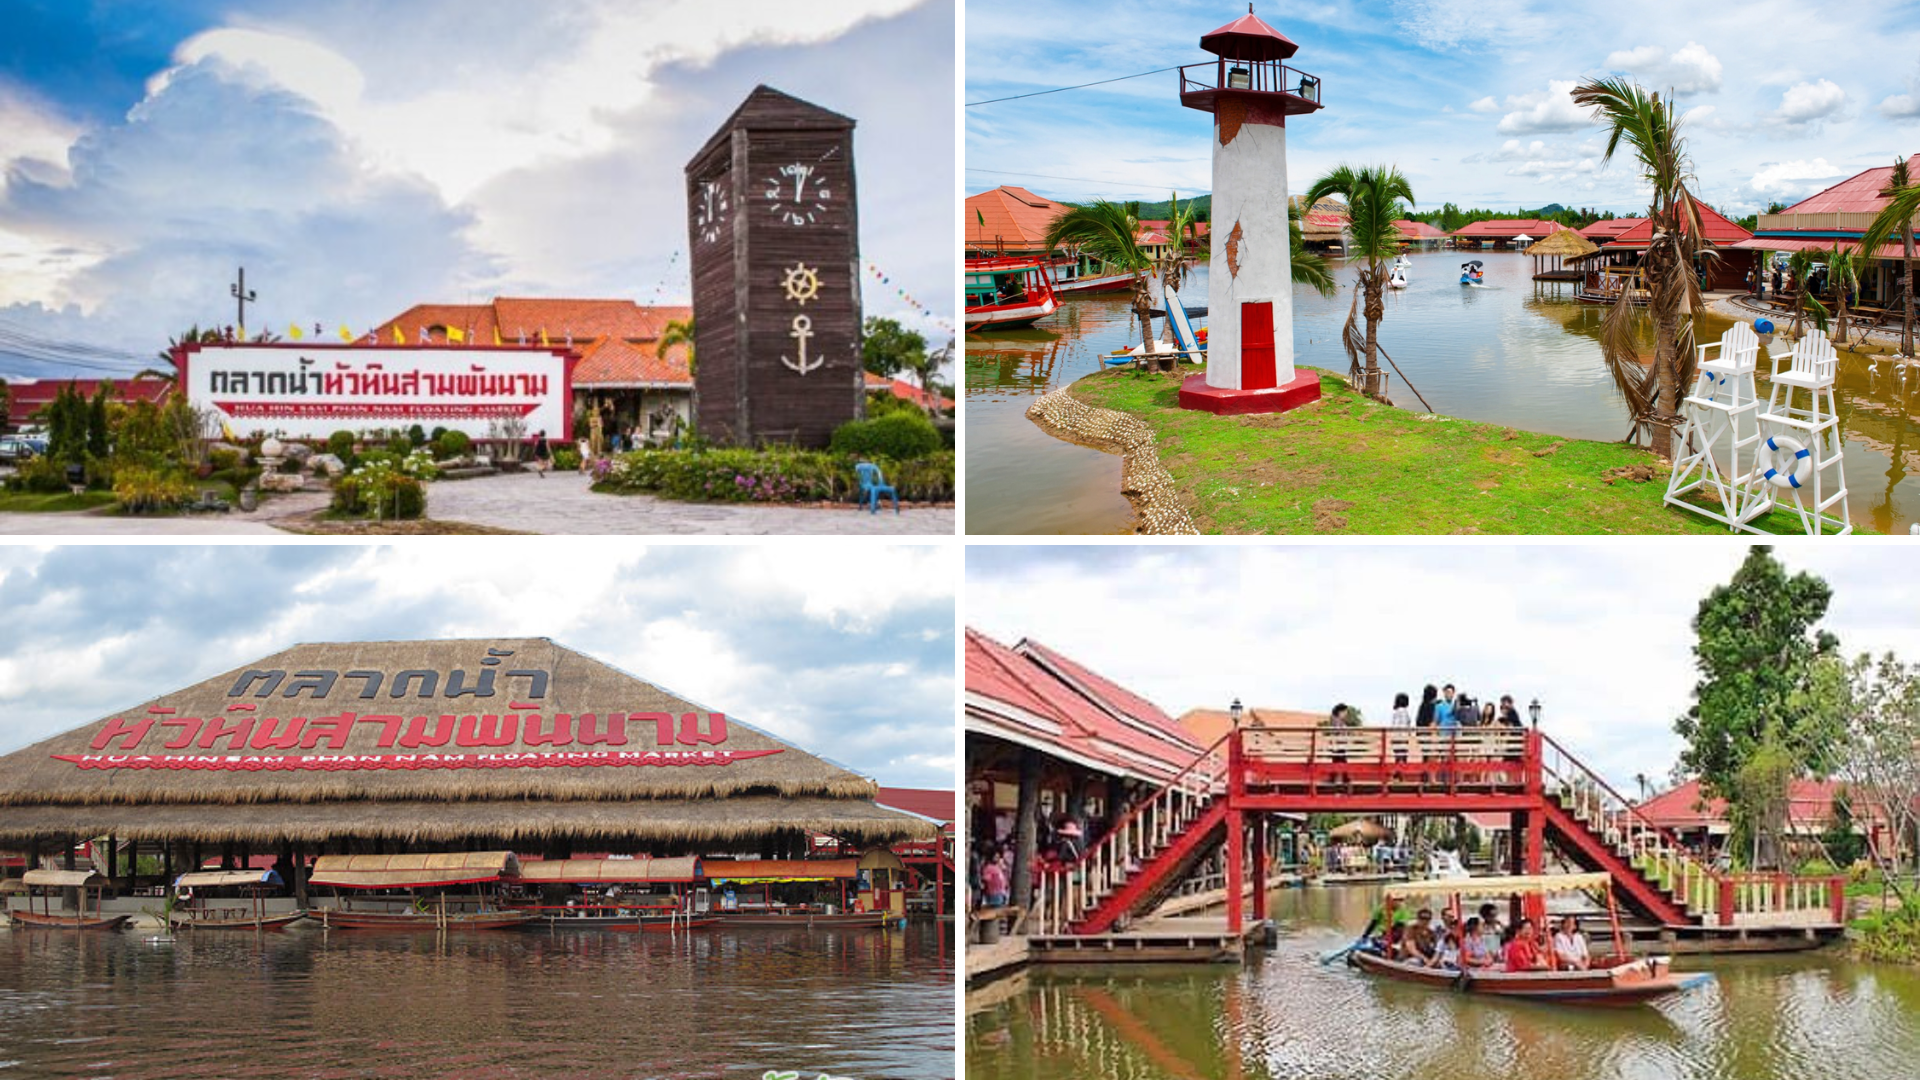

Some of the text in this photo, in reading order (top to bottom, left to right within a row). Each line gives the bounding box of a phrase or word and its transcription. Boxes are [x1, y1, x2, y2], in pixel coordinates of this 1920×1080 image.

[373, 405, 404, 413] NAM
[409, 405, 473, 413] FLOATING
[227, 647, 549, 698] ตลาดน้ำ
[90, 701, 728, 750] หัวหินสามพันนาม
[396, 753, 464, 762] NAM
[477, 752, 608, 761] FLOATING
[619, 750, 735, 759] MARKET
